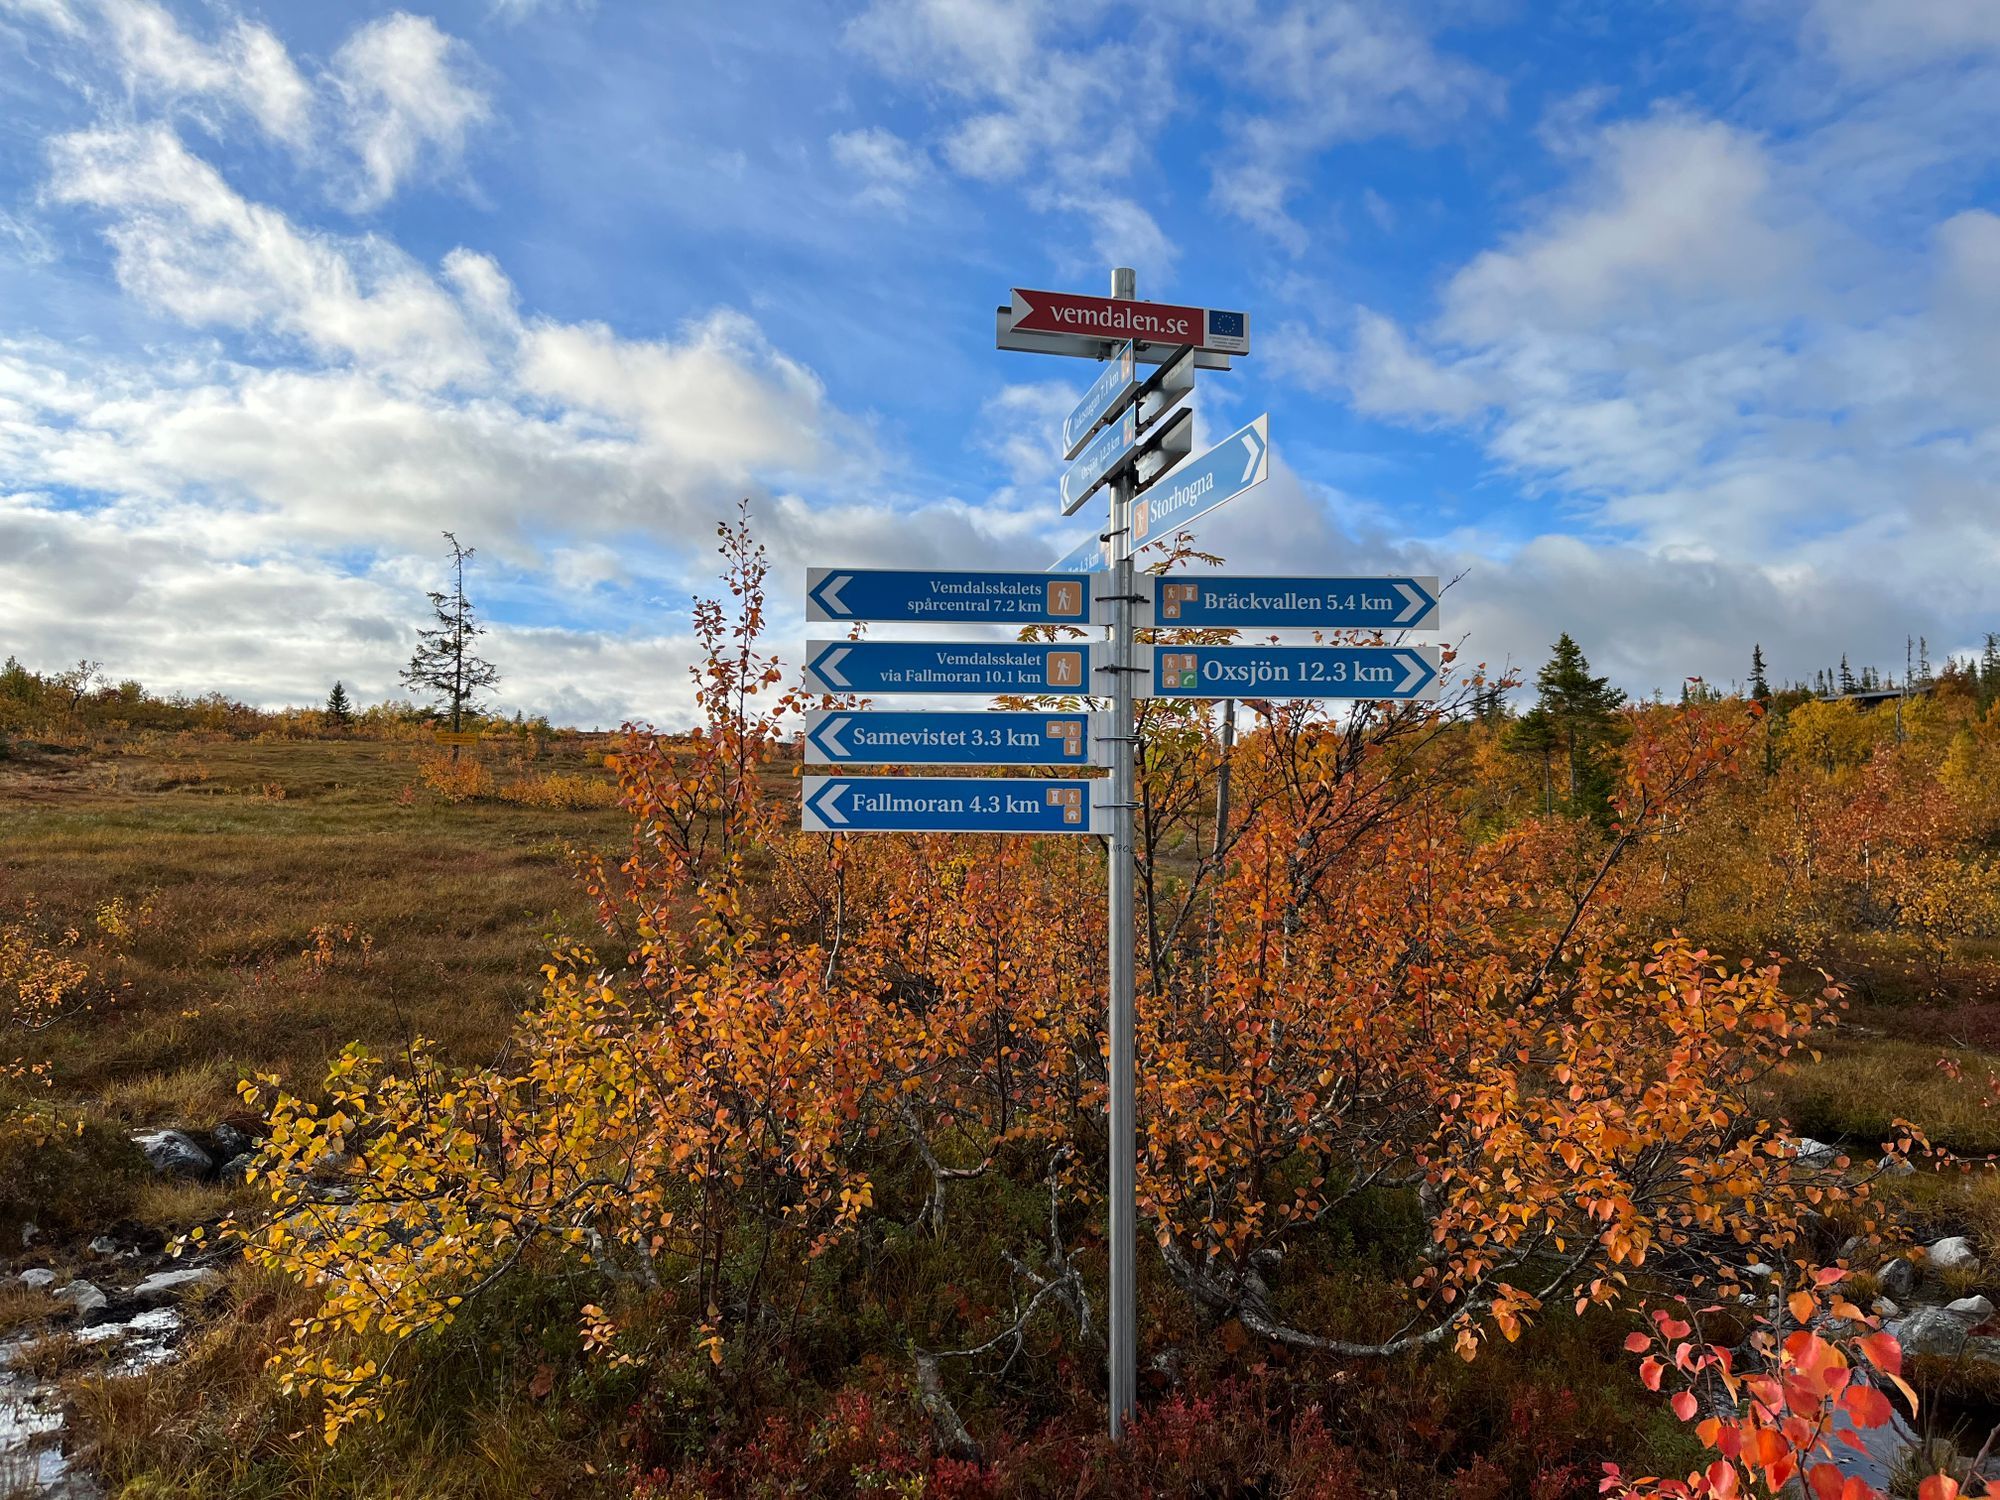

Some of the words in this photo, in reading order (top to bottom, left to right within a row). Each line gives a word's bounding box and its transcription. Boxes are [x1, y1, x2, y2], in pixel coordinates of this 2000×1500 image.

[1049, 305, 1189, 336] vemdalen.se
[1109, 370, 1119, 390] km
[1150, 472, 1214, 523] Storhogna
[930, 581, 1042, 596] Vemdalsskalets
[907, 598, 990, 613] spårcentral
[993, 599, 1015, 612] 7.2
[1018, 599, 1042, 613] km
[1204, 592, 1322, 611] Bräckvallen
[1327, 595, 1356, 611] 5.4
[1360, 594, 1393, 611] km
[936, 652, 1042, 667] Vemdalsskalet
[880, 669, 902, 682] via
[905, 669, 981, 684] Fallmoran
[984, 670, 1014, 684] 10.1
[1017, 669, 1042, 684] km
[1202, 660, 1290, 686] Oxsjön
[1298, 661, 1348, 682] 12.3
[1352, 660, 1394, 683] km
[852, 727, 967, 746] Samevistet
[970, 729, 1002, 746] 3.3
[1006, 729, 1041, 747] km
[851, 793, 964, 813] Fallmoran
[968, 795, 1001, 813] 4.3
[1005, 795, 1041, 814] km
